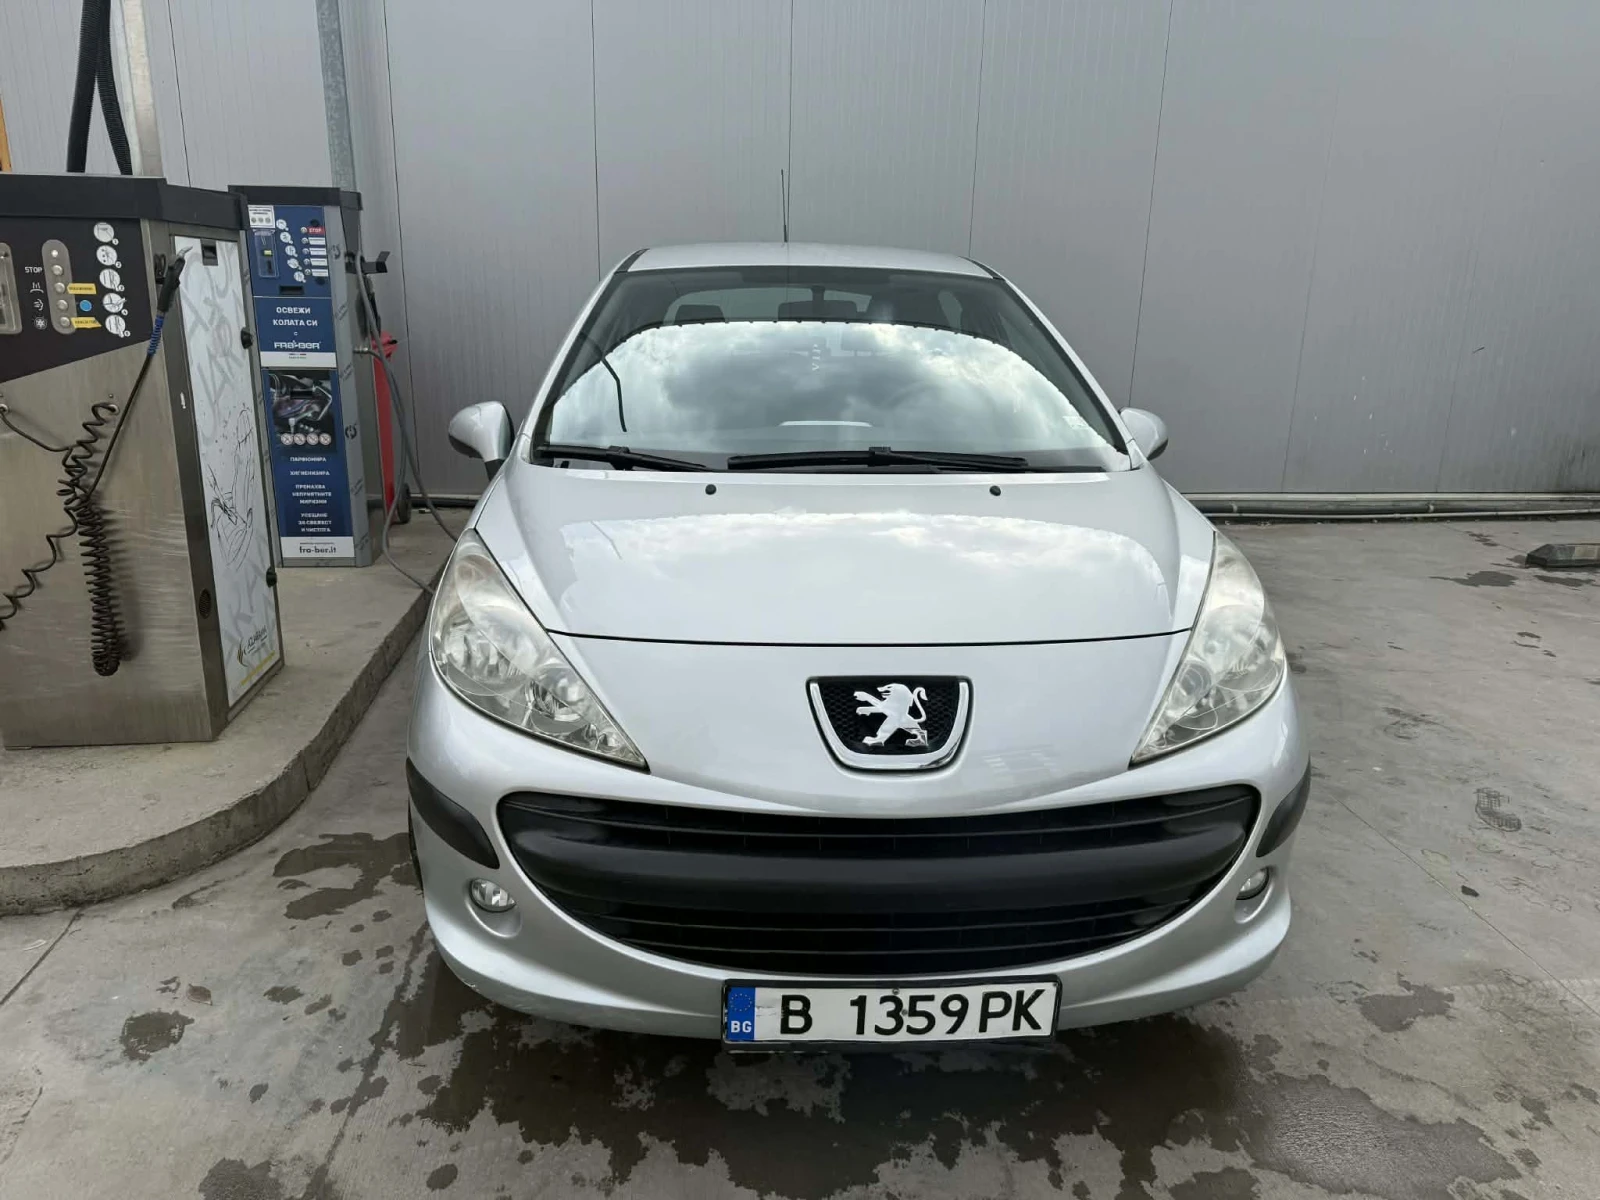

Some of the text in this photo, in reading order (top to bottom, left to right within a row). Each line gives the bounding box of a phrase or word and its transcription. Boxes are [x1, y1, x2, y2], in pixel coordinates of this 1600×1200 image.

[276, 306, 311, 314] ОСВЕЖИ
[272, 318, 318, 327] КОЛАТА СИ
[779, 994, 813, 1035] B
[730, 1020, 752, 1033] BG
